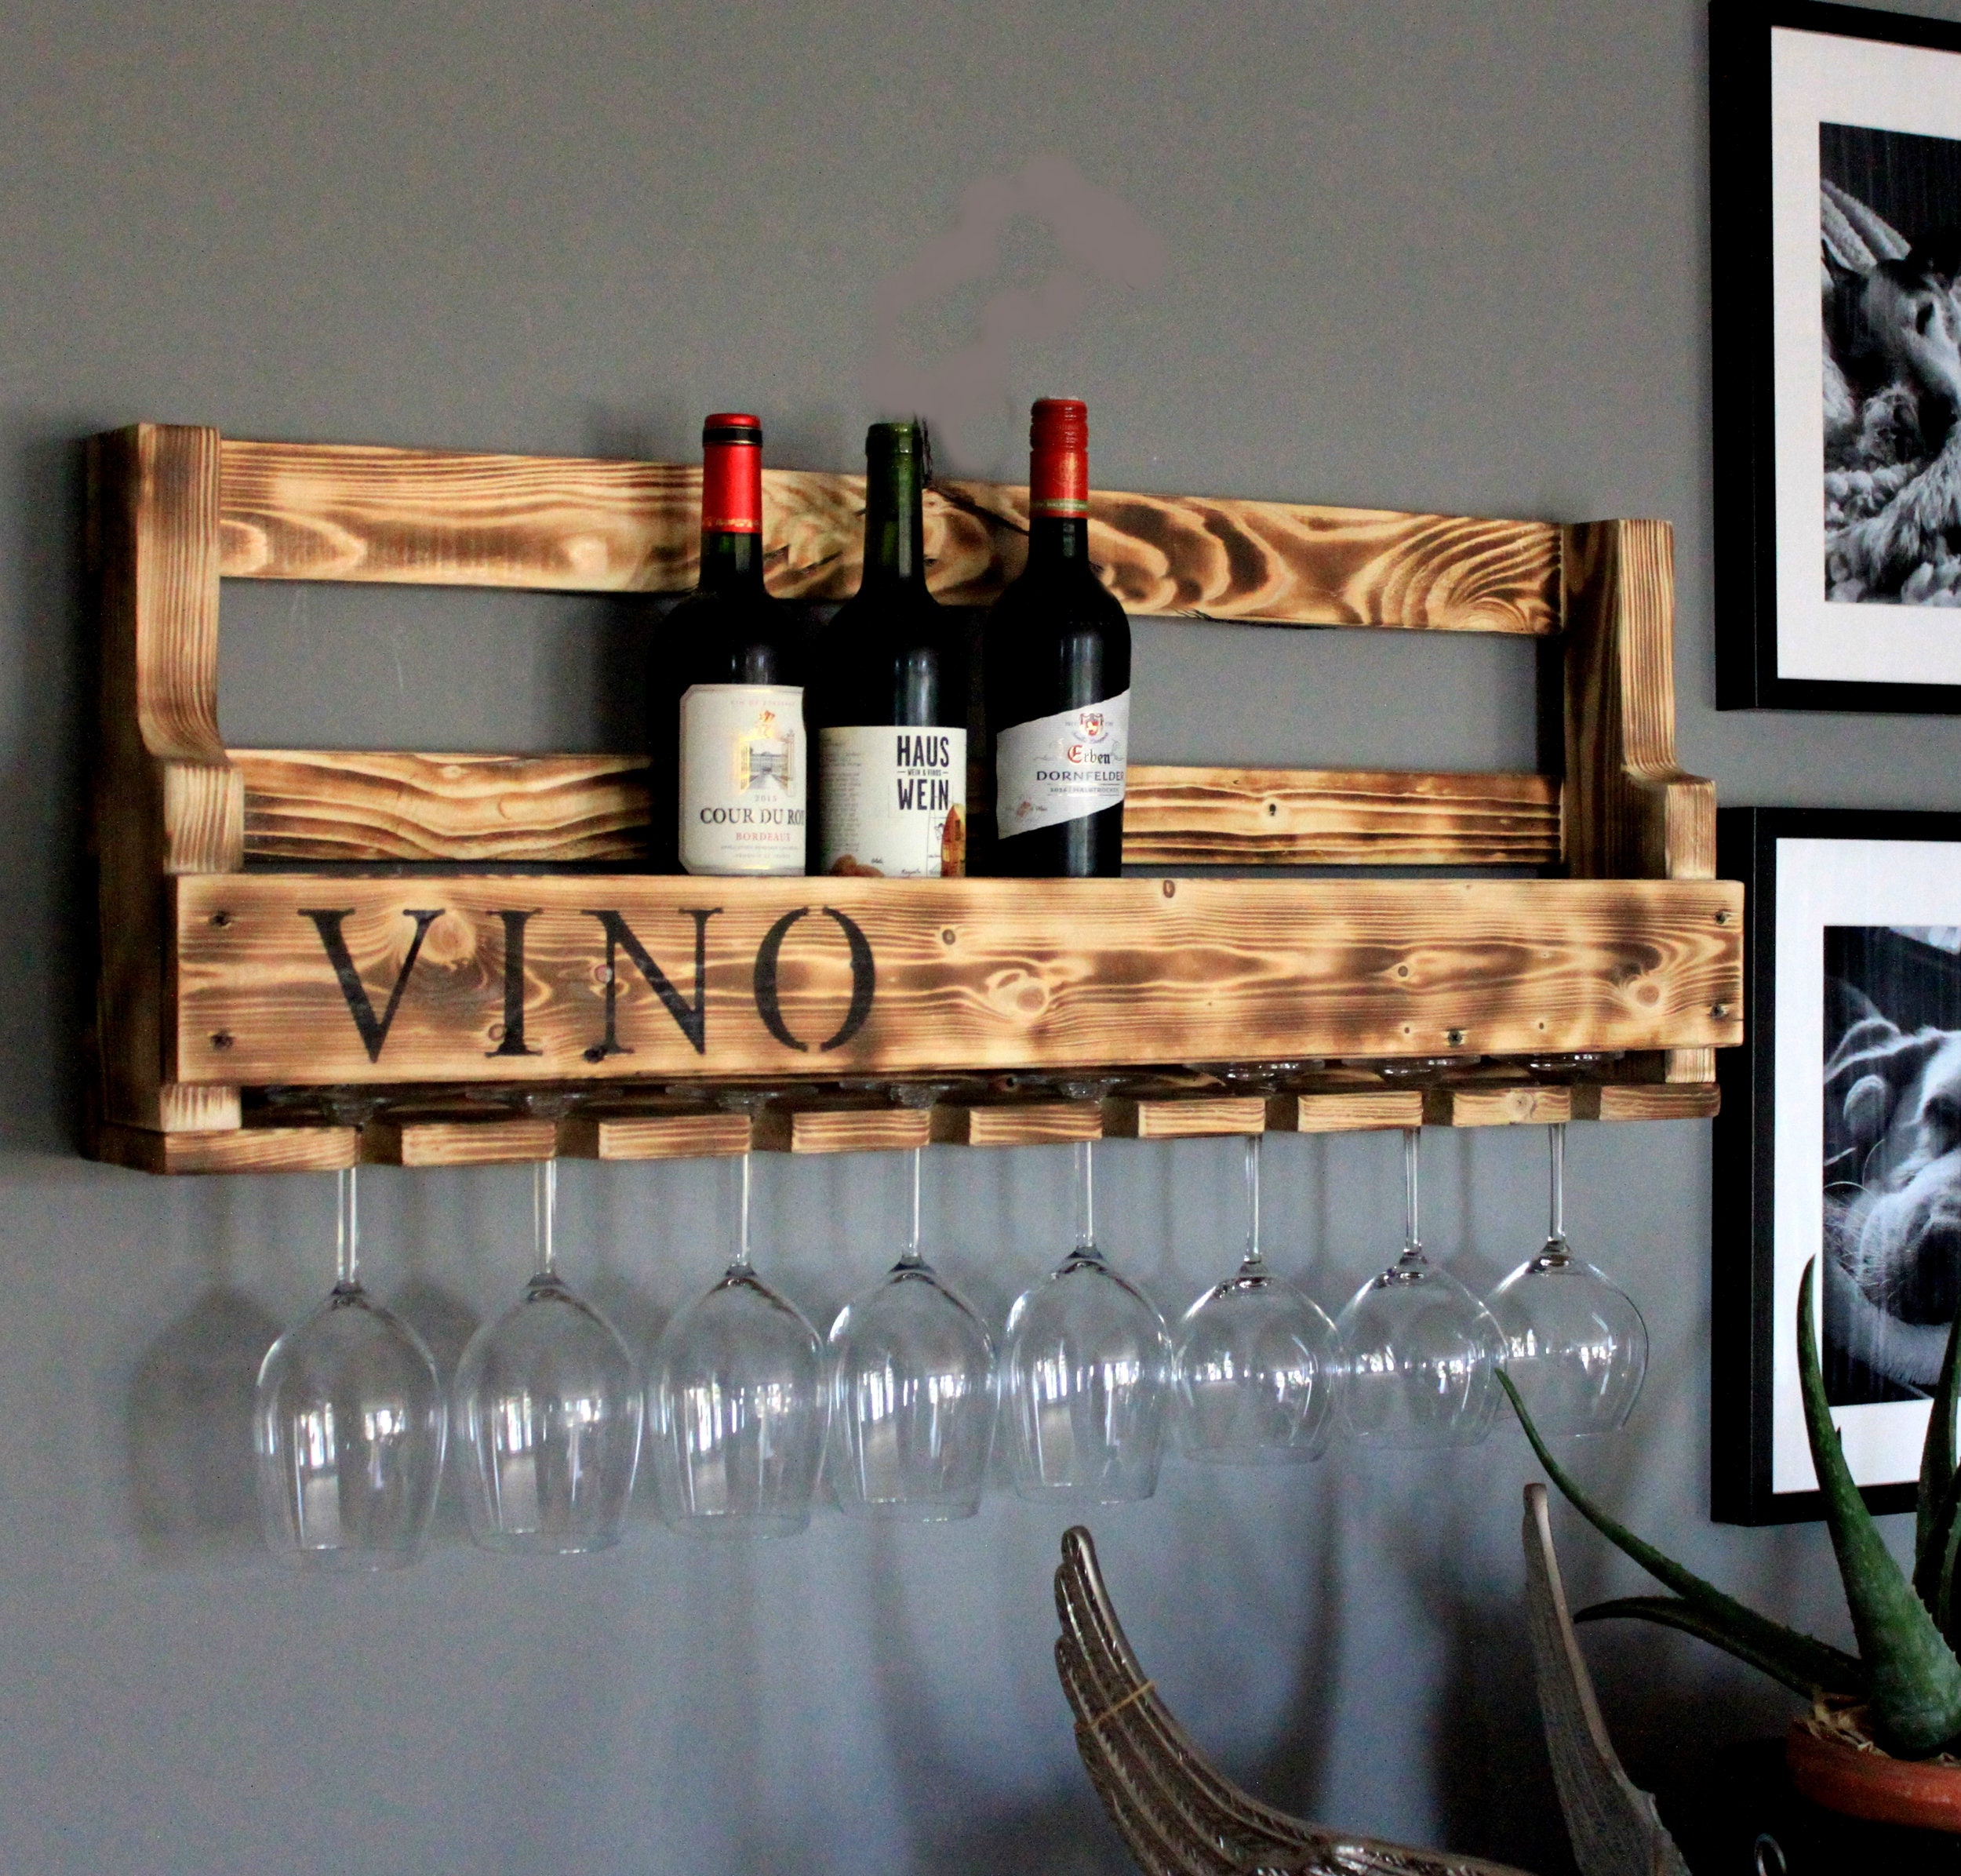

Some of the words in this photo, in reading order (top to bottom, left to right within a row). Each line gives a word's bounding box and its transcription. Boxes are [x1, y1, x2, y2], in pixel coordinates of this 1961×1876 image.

[897, 735, 949, 767] HAUS
[1068, 744, 1111, 765] Erben
[1036, 771, 1124, 781] DORNFELDER
[897, 779, 949, 810] WEIN
[700, 808, 755, 824] COUR
[759, 809, 783, 824] DU
[297, 906, 876, 1063] VINO
